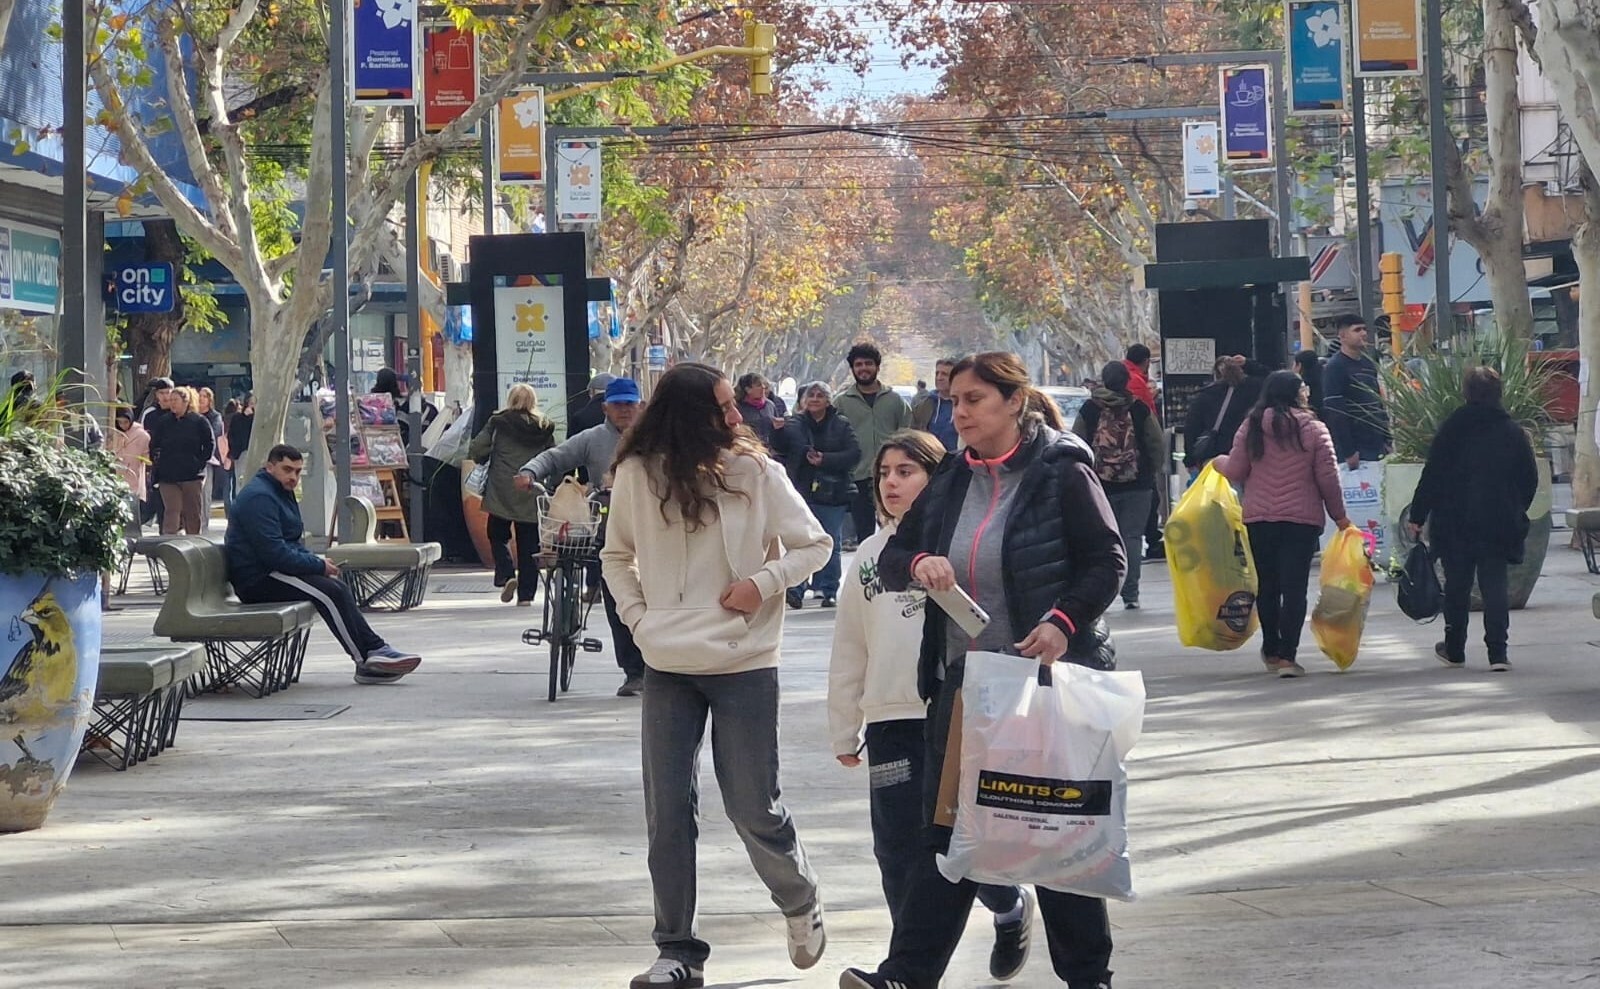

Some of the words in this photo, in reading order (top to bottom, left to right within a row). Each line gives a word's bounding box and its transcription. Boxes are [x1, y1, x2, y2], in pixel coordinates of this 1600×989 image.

[122, 268, 150, 284] on
[122, 284, 165, 306] city
[980, 778, 1050, 797] LIMITS
[993, 812, 1019, 821] GALERIA
[1020, 815, 1049, 824] CENTRAL
